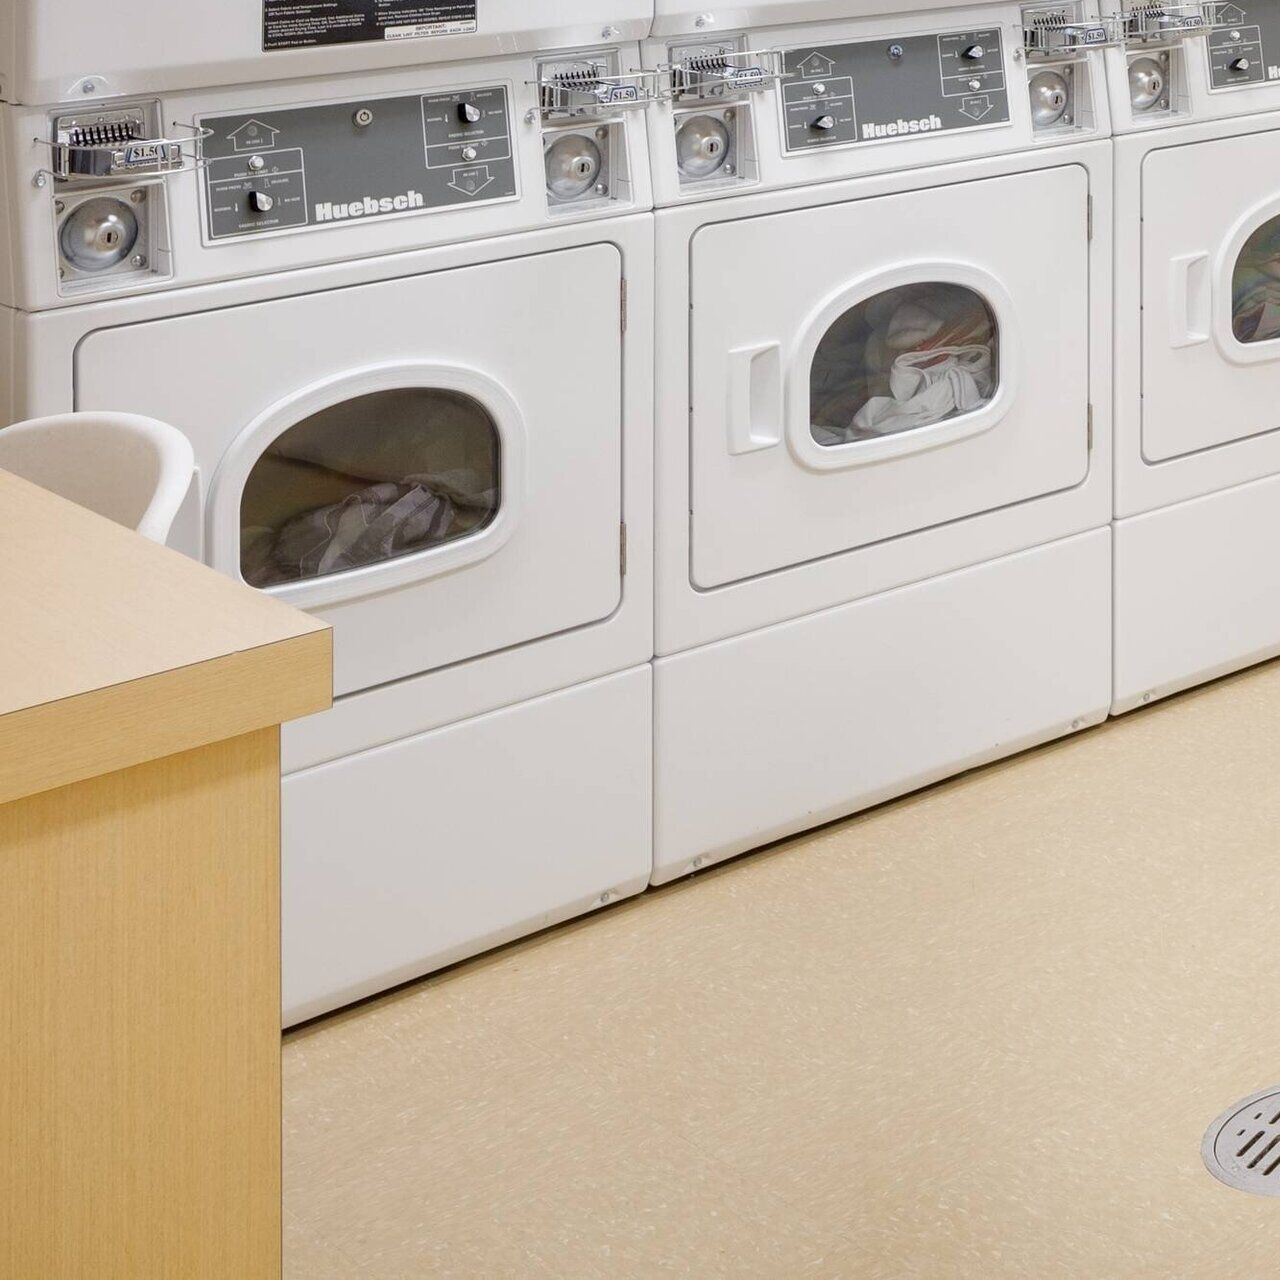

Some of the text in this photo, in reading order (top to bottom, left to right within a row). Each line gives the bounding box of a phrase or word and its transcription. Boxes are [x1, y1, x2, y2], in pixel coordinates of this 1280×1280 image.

[1087, 32, 1104, 40] $1.50
[613, 89, 635, 100] $1.50
[862, 114, 942, 139] Huebsch
[315, 190, 424, 222] Huebsch
